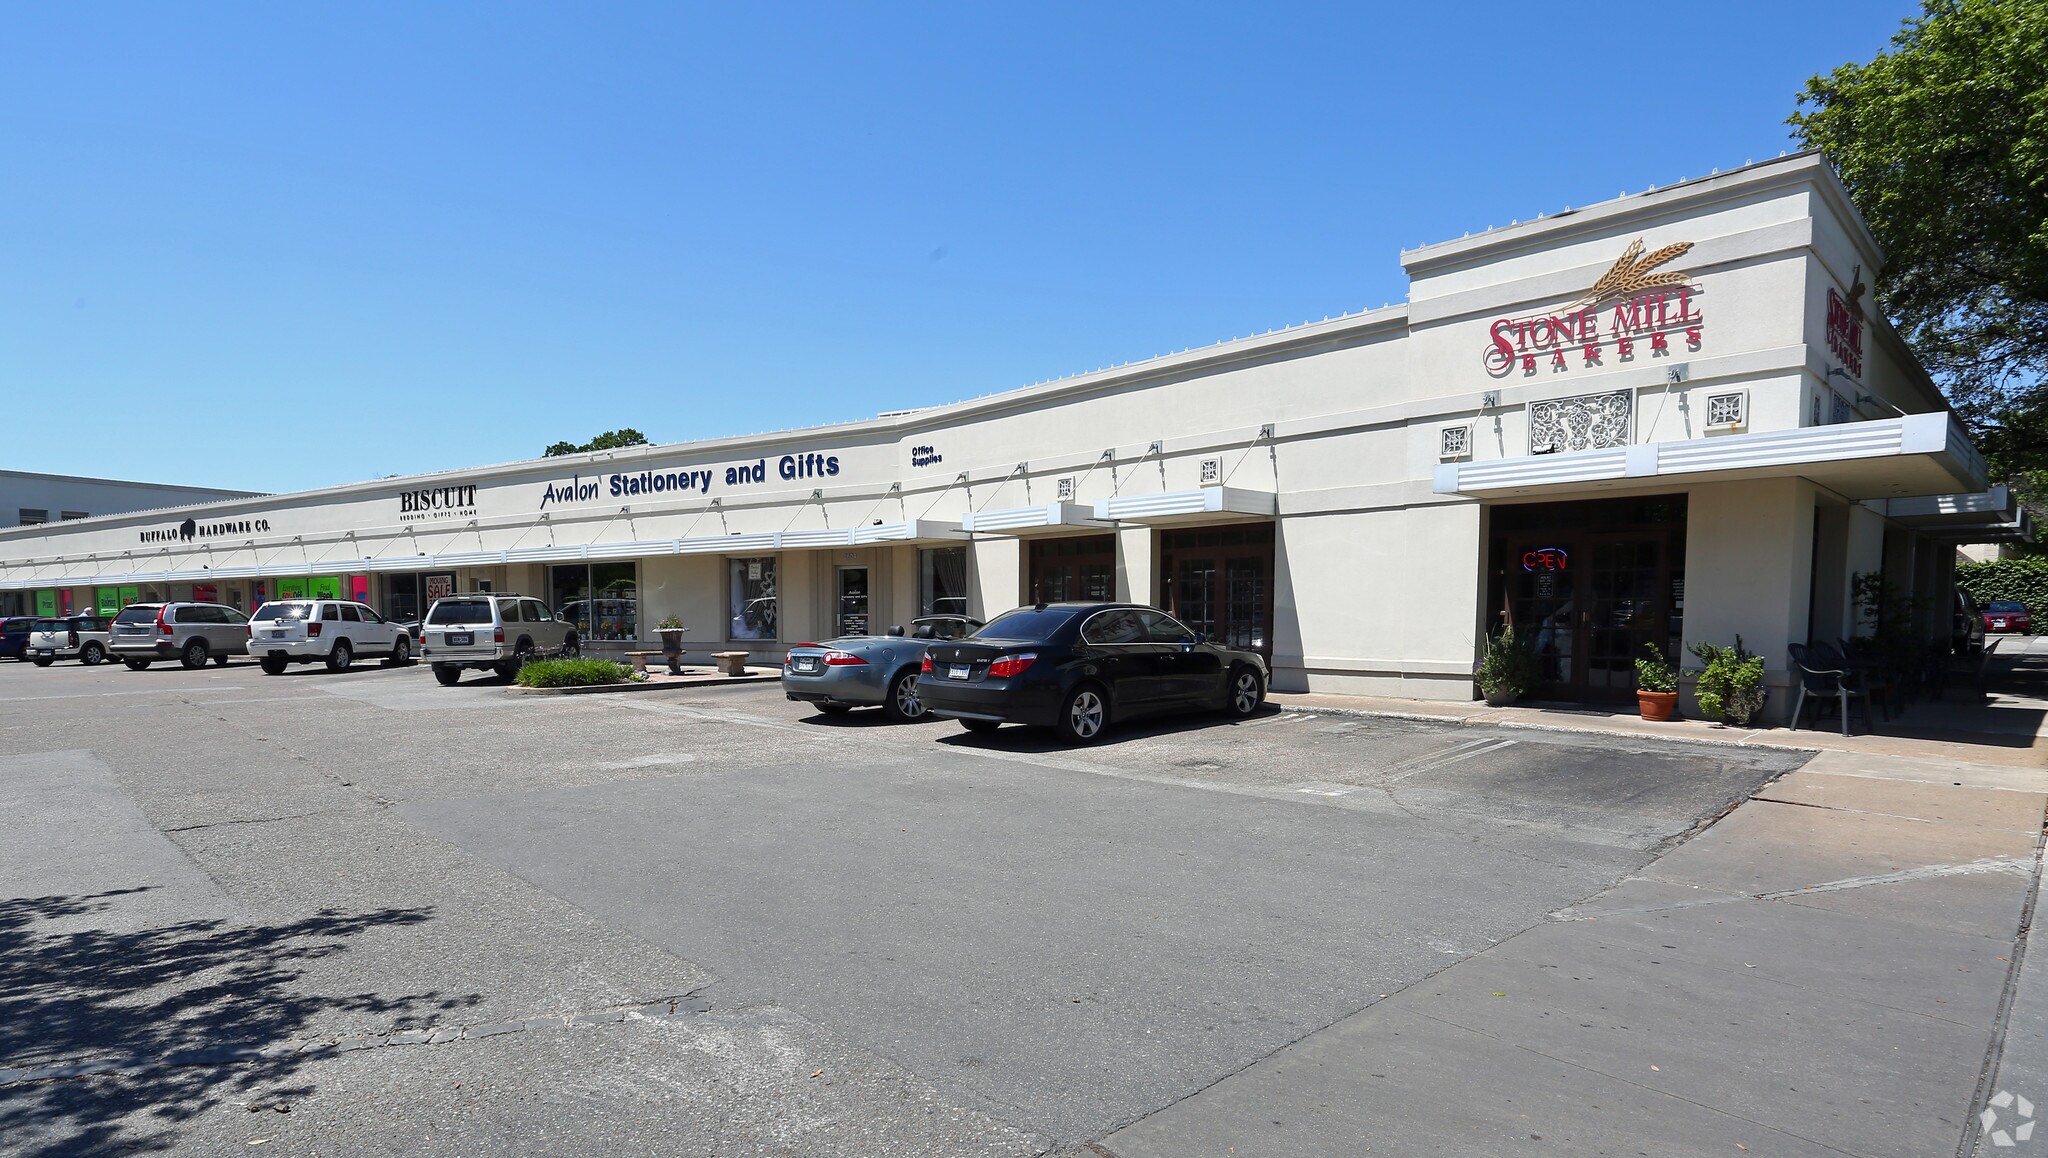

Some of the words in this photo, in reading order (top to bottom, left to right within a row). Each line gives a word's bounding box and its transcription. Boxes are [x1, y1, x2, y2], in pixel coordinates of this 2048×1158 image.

[1482, 308, 1598, 371] STONE
[1610, 290, 1702, 331] MILL
[1522, 325, 1702, 370] BAKERS
[912, 446, 934, 457] Office
[912, 454, 942, 468] Supplies
[540, 474, 599, 510] Avalon
[610, 470, 712, 494] Stationery
[725, 459, 767, 486] and
[779, 453, 840, 480] Gifts
[400, 484, 477, 512] BISCUIT
[400, 513, 425, 521] BEDDING
[433, 511, 451, 519] GIFTS
[140, 528, 178, 543] BUFFALO
[199, 520, 252, 538] HARDWARE
[1523, 552, 1567, 569] OPEN
[427, 584, 451, 599] SALE
